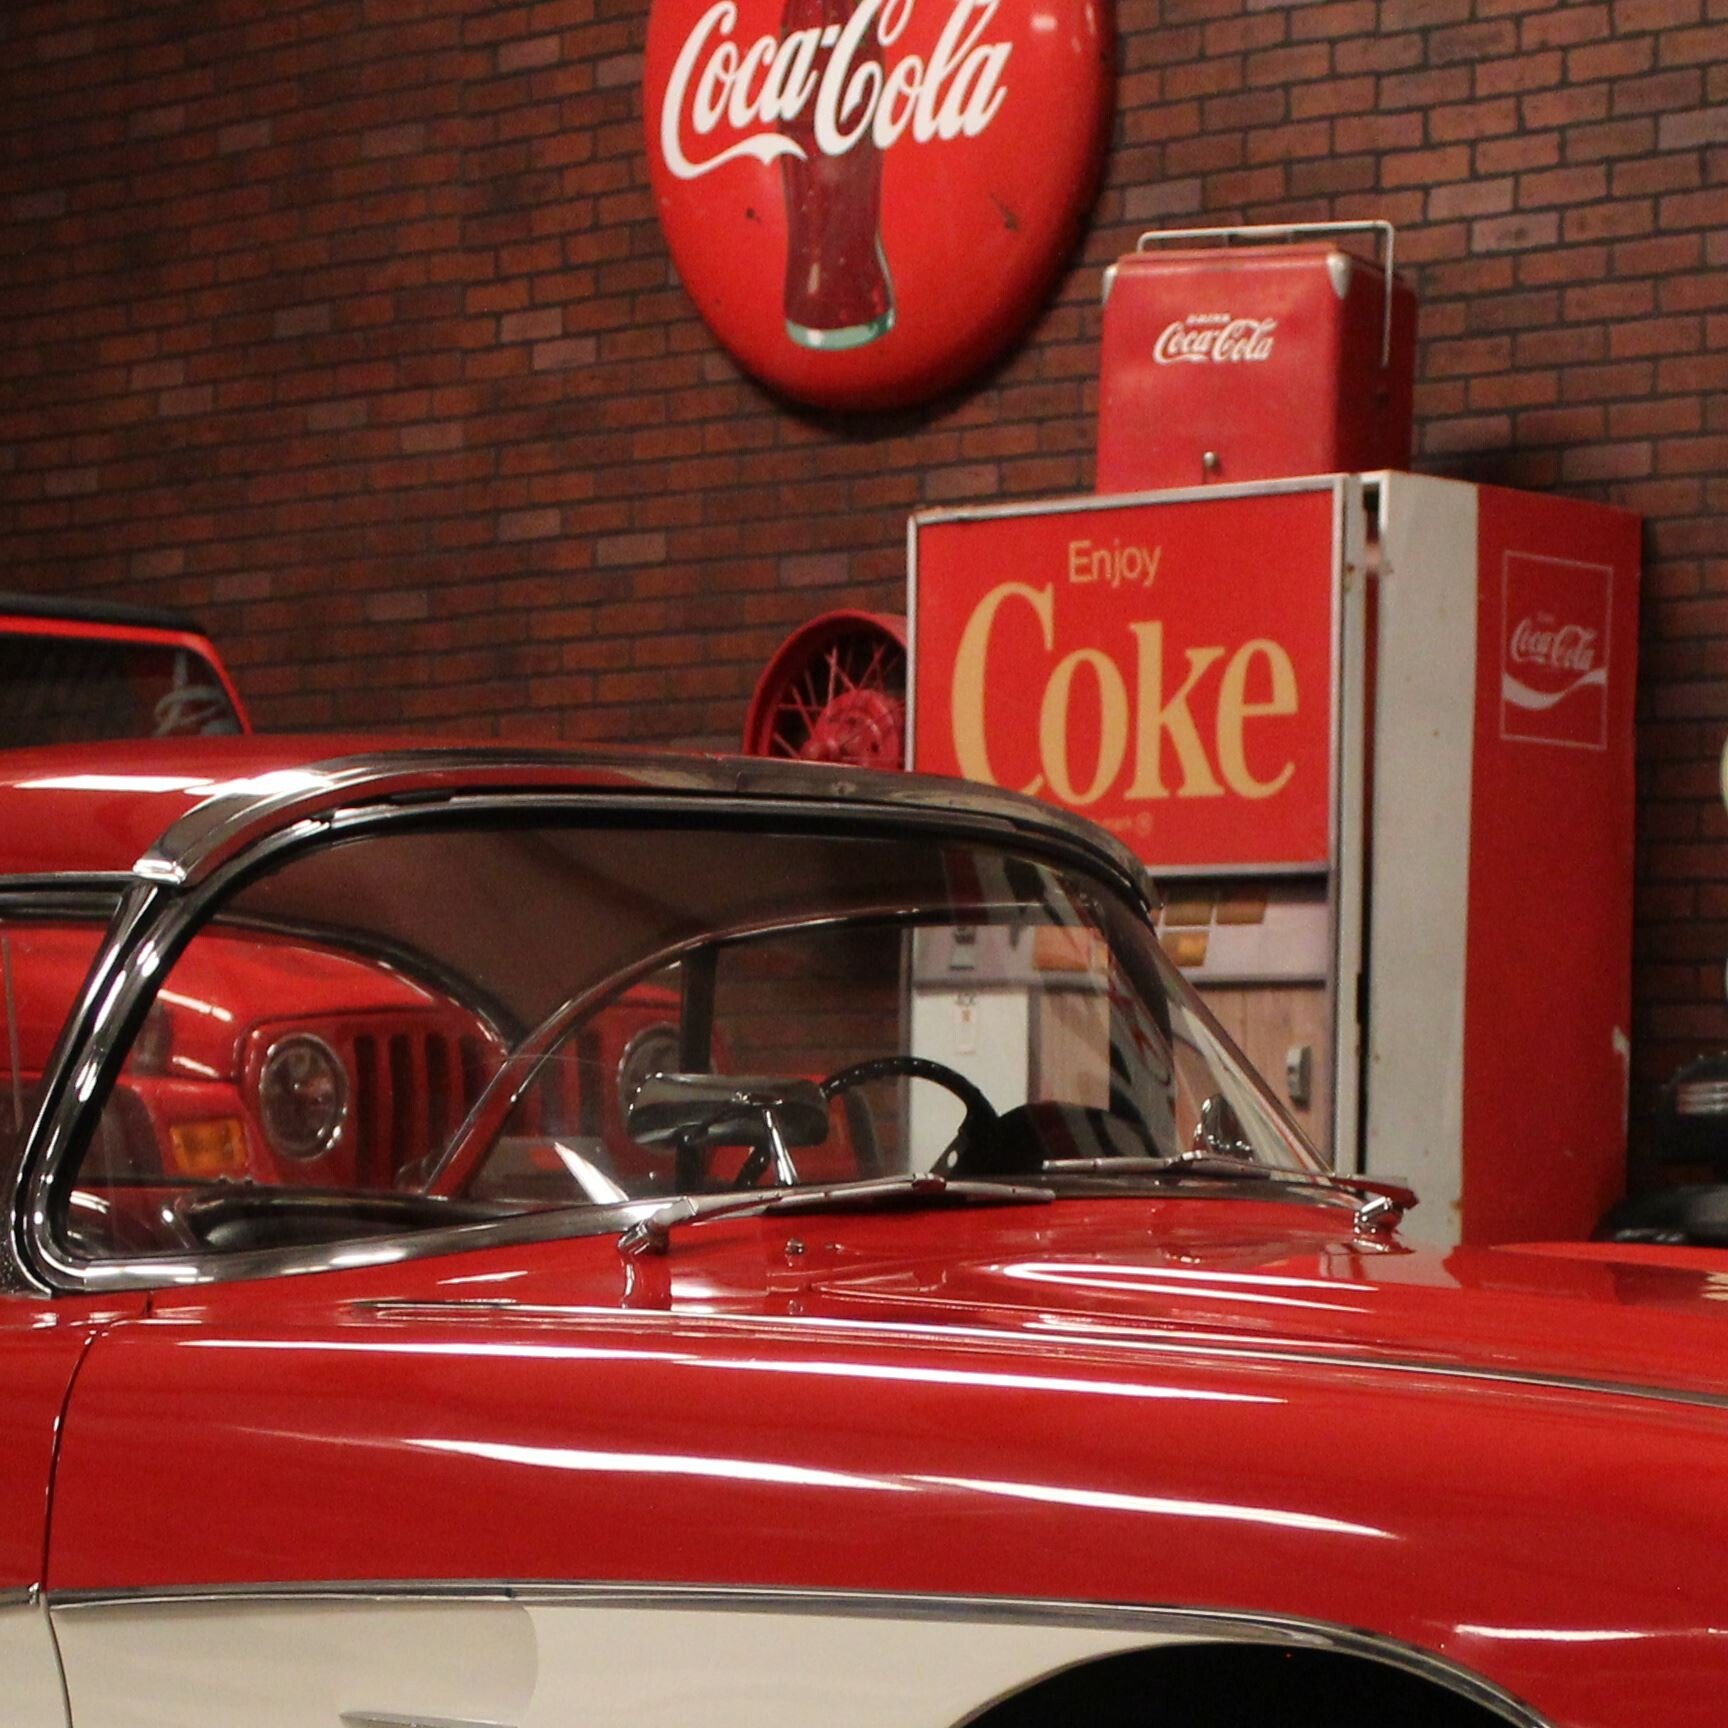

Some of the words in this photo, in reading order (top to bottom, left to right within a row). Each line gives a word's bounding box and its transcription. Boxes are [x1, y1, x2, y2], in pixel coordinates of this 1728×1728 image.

[661, 0, 1014, 180] Coca-Cola
[1152, 319, 1278, 366] Coca-Cola
[1068, 539, 1162, 585] Enjoy
[1511, 617, 1597, 671] Coca-Cola
[951, 581, 1298, 804] Coke
